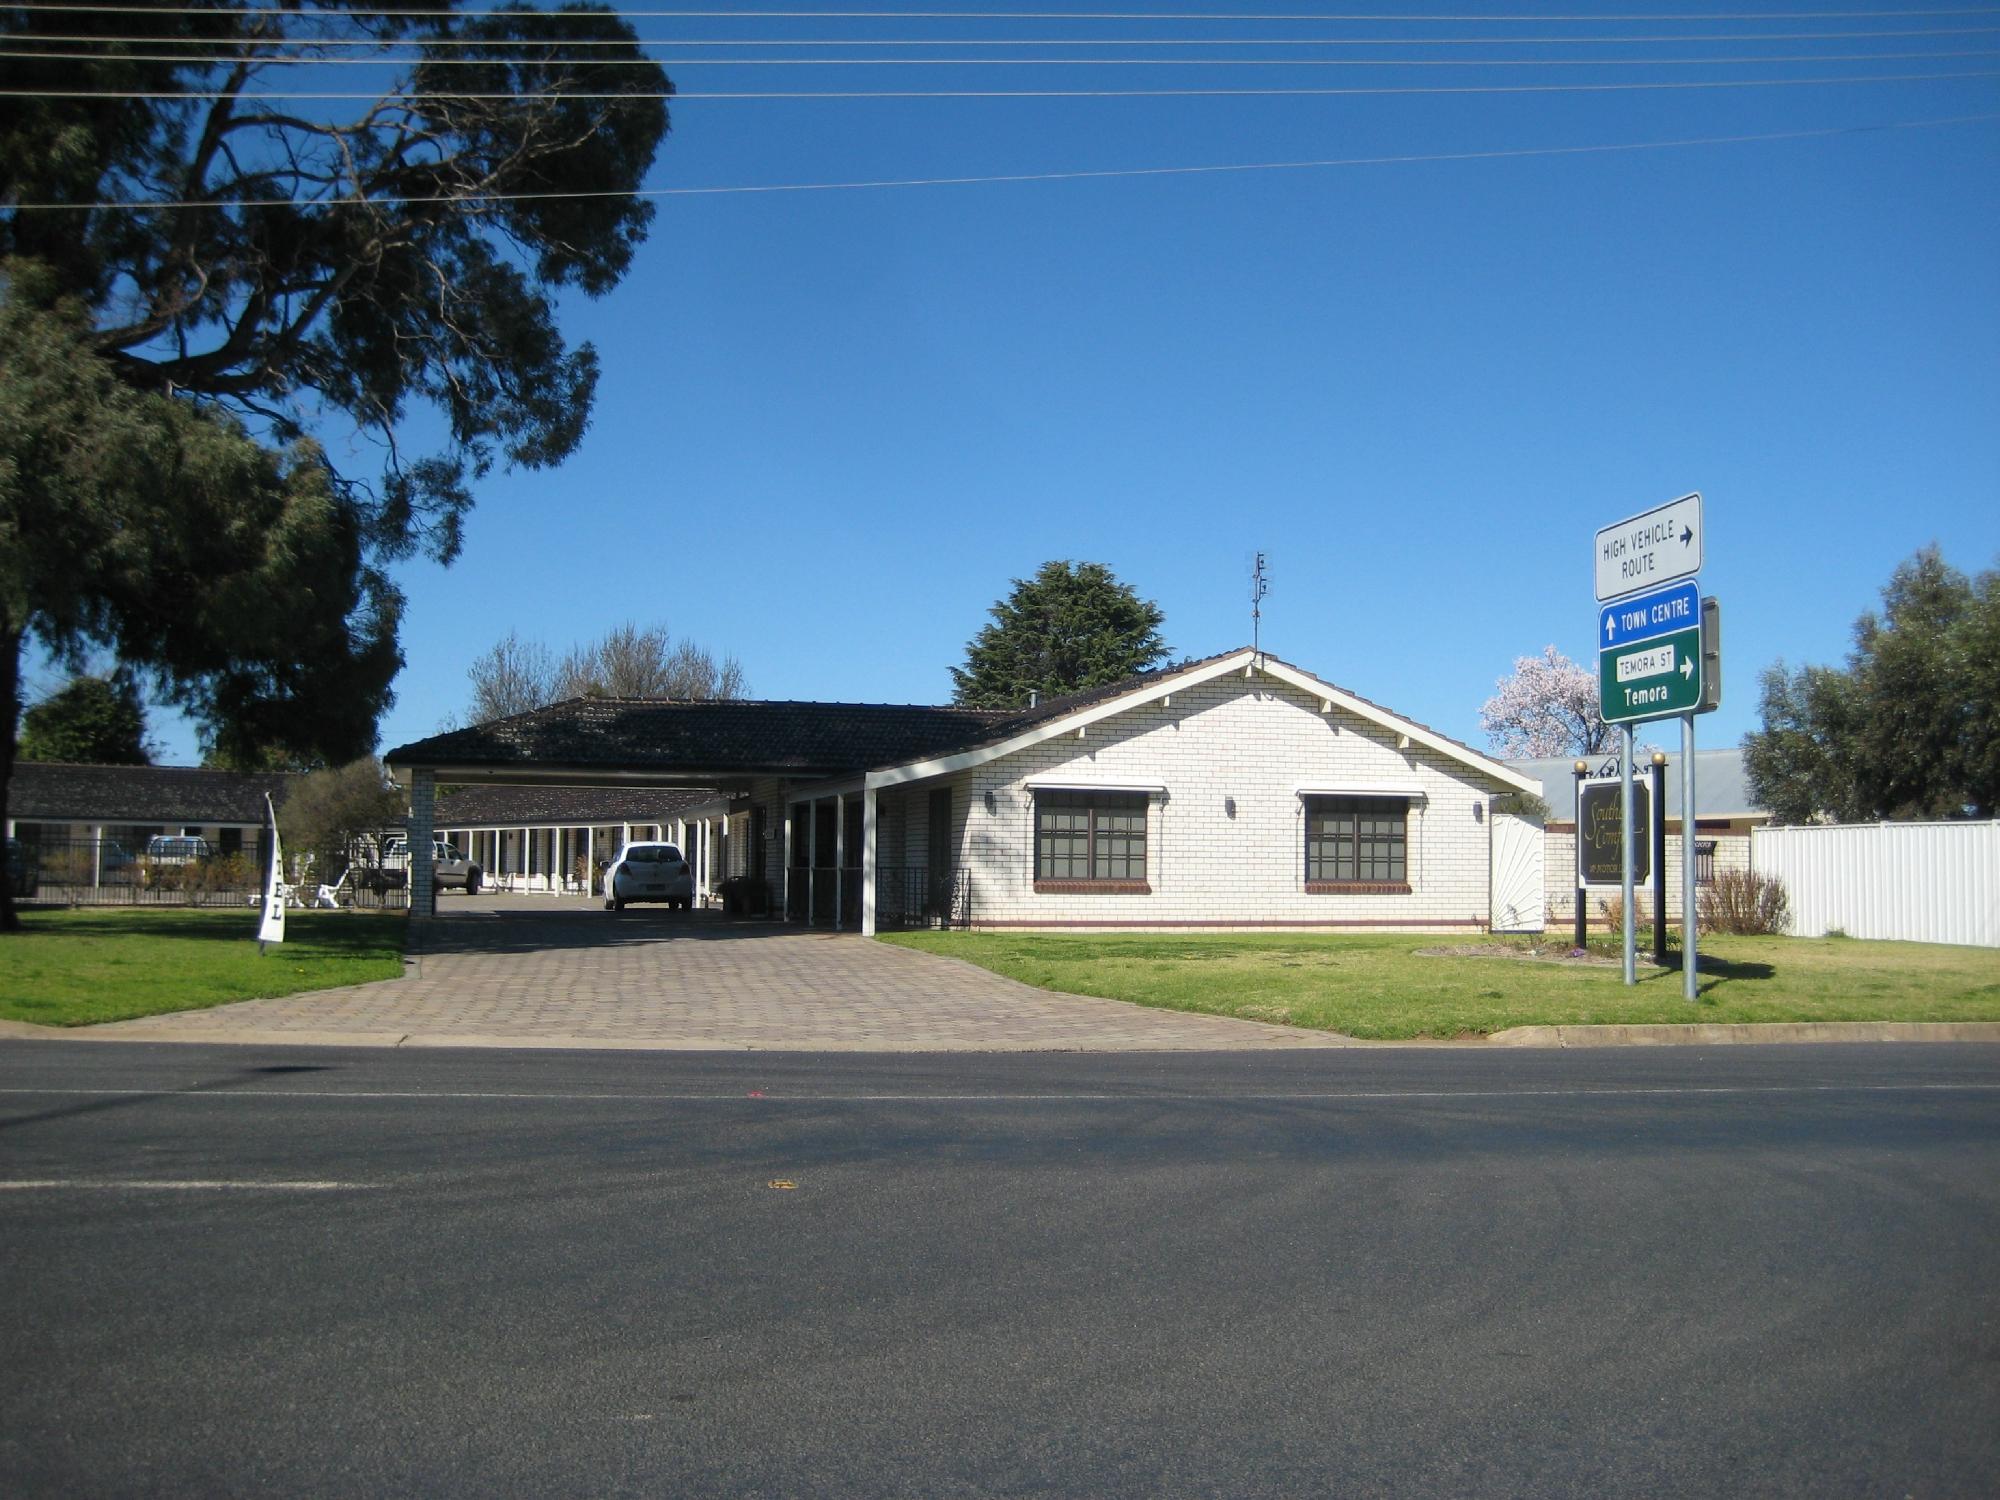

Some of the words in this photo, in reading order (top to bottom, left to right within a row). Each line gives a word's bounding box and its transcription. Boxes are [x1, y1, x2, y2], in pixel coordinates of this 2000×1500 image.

[1603, 539, 1626, 562] HIGH
[1630, 519, 1675, 551] VEHICLE
[1621, 552, 1656, 579] ROUTE
[1621, 608, 1647, 632] TOWN
[1651, 597, 1690, 624] CENTRE
[1619, 656, 1655, 676] TEMORA
[1660, 651, 1672, 667] ST
[1624, 685, 1668, 707] Temora
